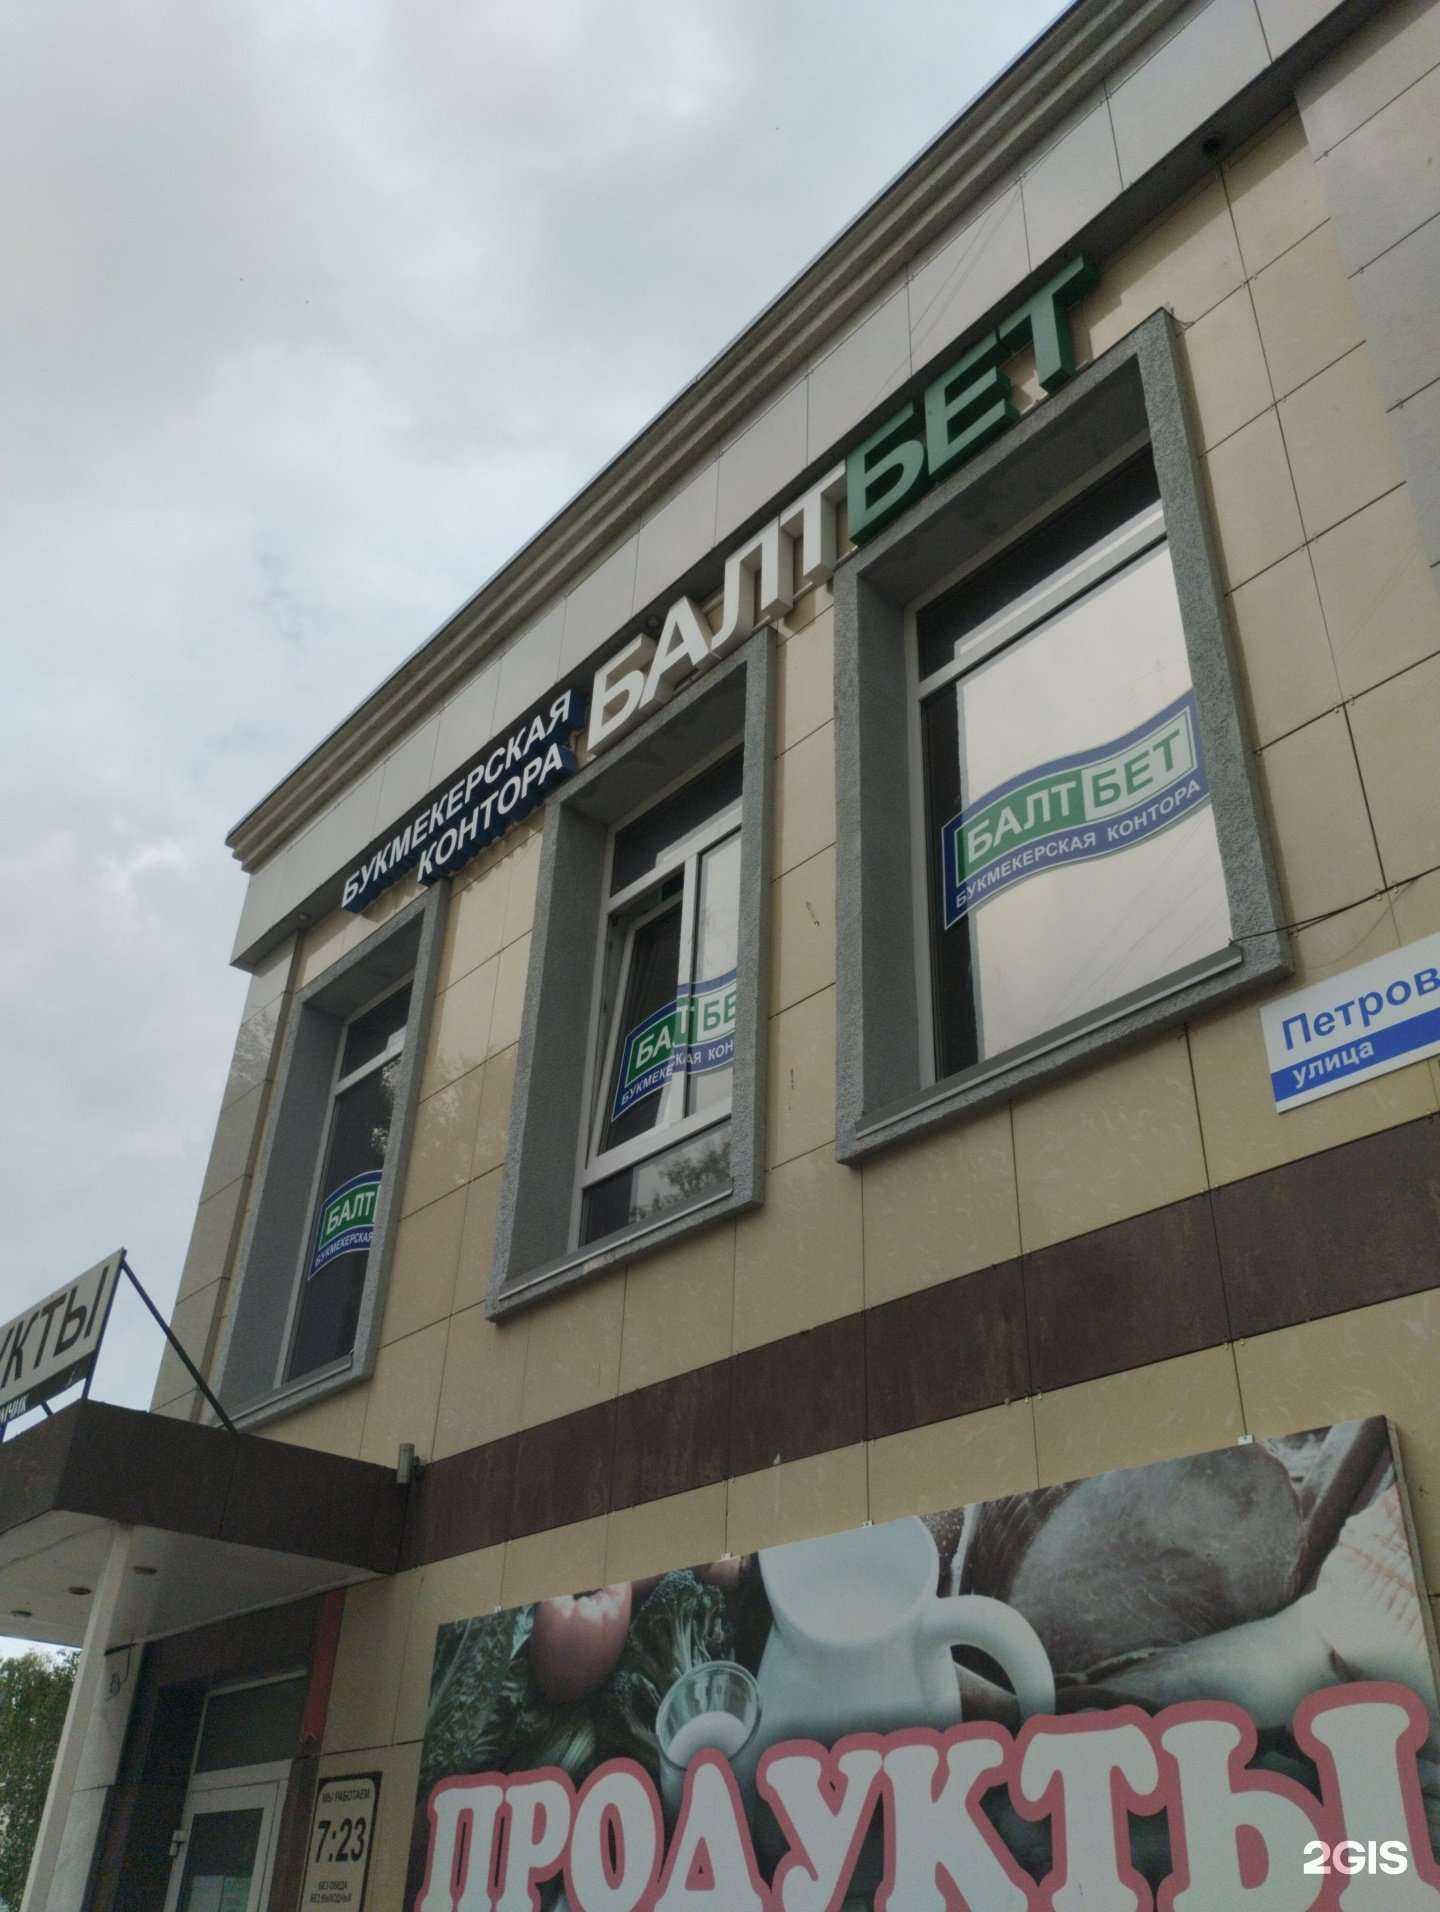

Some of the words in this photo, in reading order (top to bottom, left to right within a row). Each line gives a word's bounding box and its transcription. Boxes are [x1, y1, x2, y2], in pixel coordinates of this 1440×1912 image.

[341, 689, 573, 908] БУКМЕКЕРСКАЯ
[417, 743, 564, 882] КОНТОРА
[956, 832, 1097, 909] БУКМЕКЕРСКАЯ
[1107, 779, 1201, 842] КОНТОРА
[1292, 1040, 1375, 1089] улица
[326, 1191, 376, 1236] БАЛТ
[315, 1817, 367, 1863] 7:23
[417, 1692, 1440, 1912] ПРОДУКТЫ
